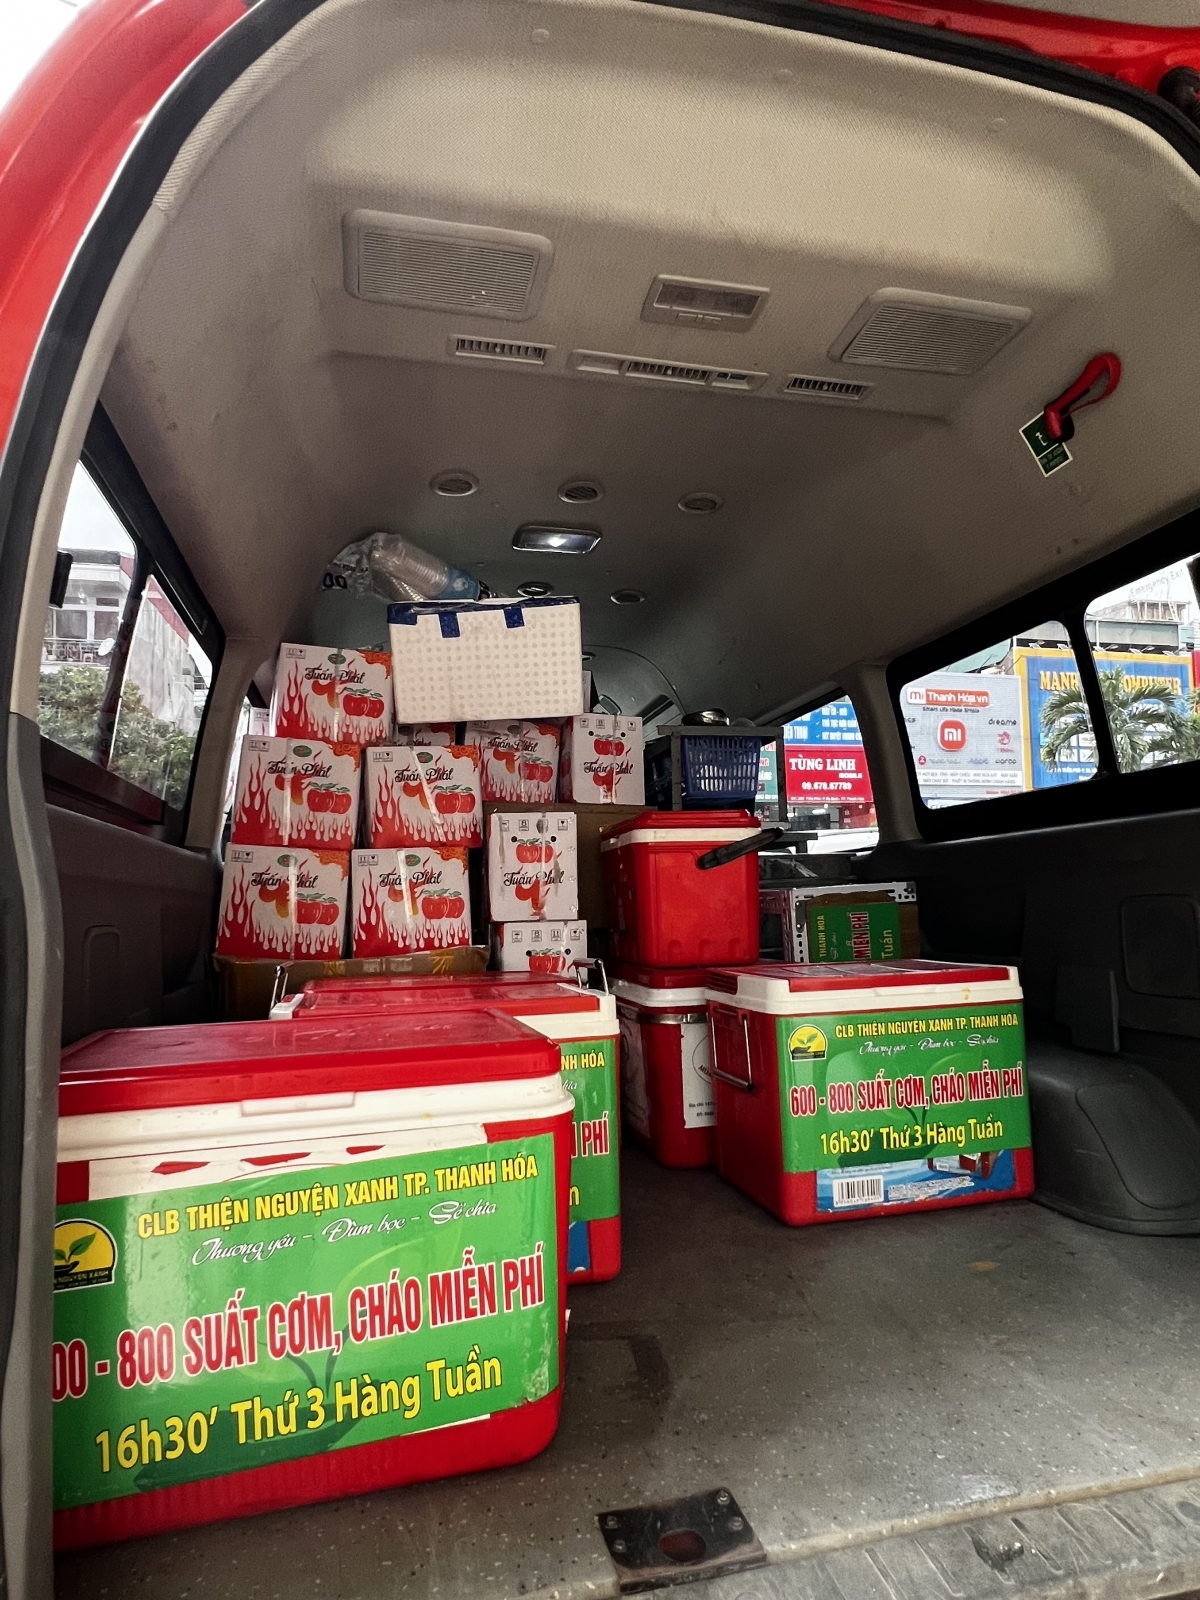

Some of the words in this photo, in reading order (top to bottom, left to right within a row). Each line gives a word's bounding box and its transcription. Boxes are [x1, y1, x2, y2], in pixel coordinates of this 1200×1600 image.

[304, 666, 333, 681] Tuấn
[927, 691, 956, 702] Thanh
[788, 753, 824, 771] TÙNG
[826, 758, 856, 771] LINH
[503, 871, 532, 886] Tuấn
[834, 1024, 855, 1038] CLB
[857, 1020, 886, 1039] THIỆN
[887, 1017, 926, 1036] NGUYỆN
[928, 1017, 954, 1032] XANH
[955, 1017, 968, 1030] TP.
[970, 1014, 999, 1029] THANH
[580, 1049, 606, 1069] HÓA
[790, 1084, 817, 1117] 600
[828, 1081, 855, 1114] 800
[856, 1068, 893, 1112] SUẤT
[894, 1073, 930, 1110] CƠM,
[931, 1066, 965, 1106] CHÁO
[967, 1059, 1001, 1102] MIỄN
[1001, 1061, 1023, 1098] PHÍ
[581, 1110, 610, 1158] PHÍ
[879, 1124, 911, 1150] Thứ
[913, 1125, 923, 1147] 3
[926, 1121, 965, 1148] Hàng
[967, 1113, 1003, 1140] Tuần
[137, 1209, 180, 1239] CLB
[186, 1195, 250, 1231] THIỆN
[255, 1181, 339, 1222] NGUYỆN
[343, 1174, 399, 1208] XANH
[403, 1171, 430, 1198] TP.
[434, 1159, 497, 1192] THANH
[501, 1151, 539, 1183] HÓA
[191, 1237, 265, 1266] Thương
[257, 1233, 298, 1262] yêu
[321, 1216, 373, 1243] Đùm
[376, 1213, 407, 1235] bọc
[464, 1198, 497, 1218] chia
[52, 1338, 88, 1402] 00
[116, 1322, 176, 1390] 800
[182, 1287, 261, 1378] SUẤT
[266, 1291, 343, 1361] CƠM,
[348, 1267, 423, 1344] CHÁO
[428, 1245, 498, 1329] MIỄN
[501, 1240, 545, 1314] PHÍ
[230, 1388, 300, 1445] Thứ
[305, 1385, 326, 1431] 3
[333, 1373, 421, 1424] Hàng
[425, 1343, 503, 1402] Tuần
